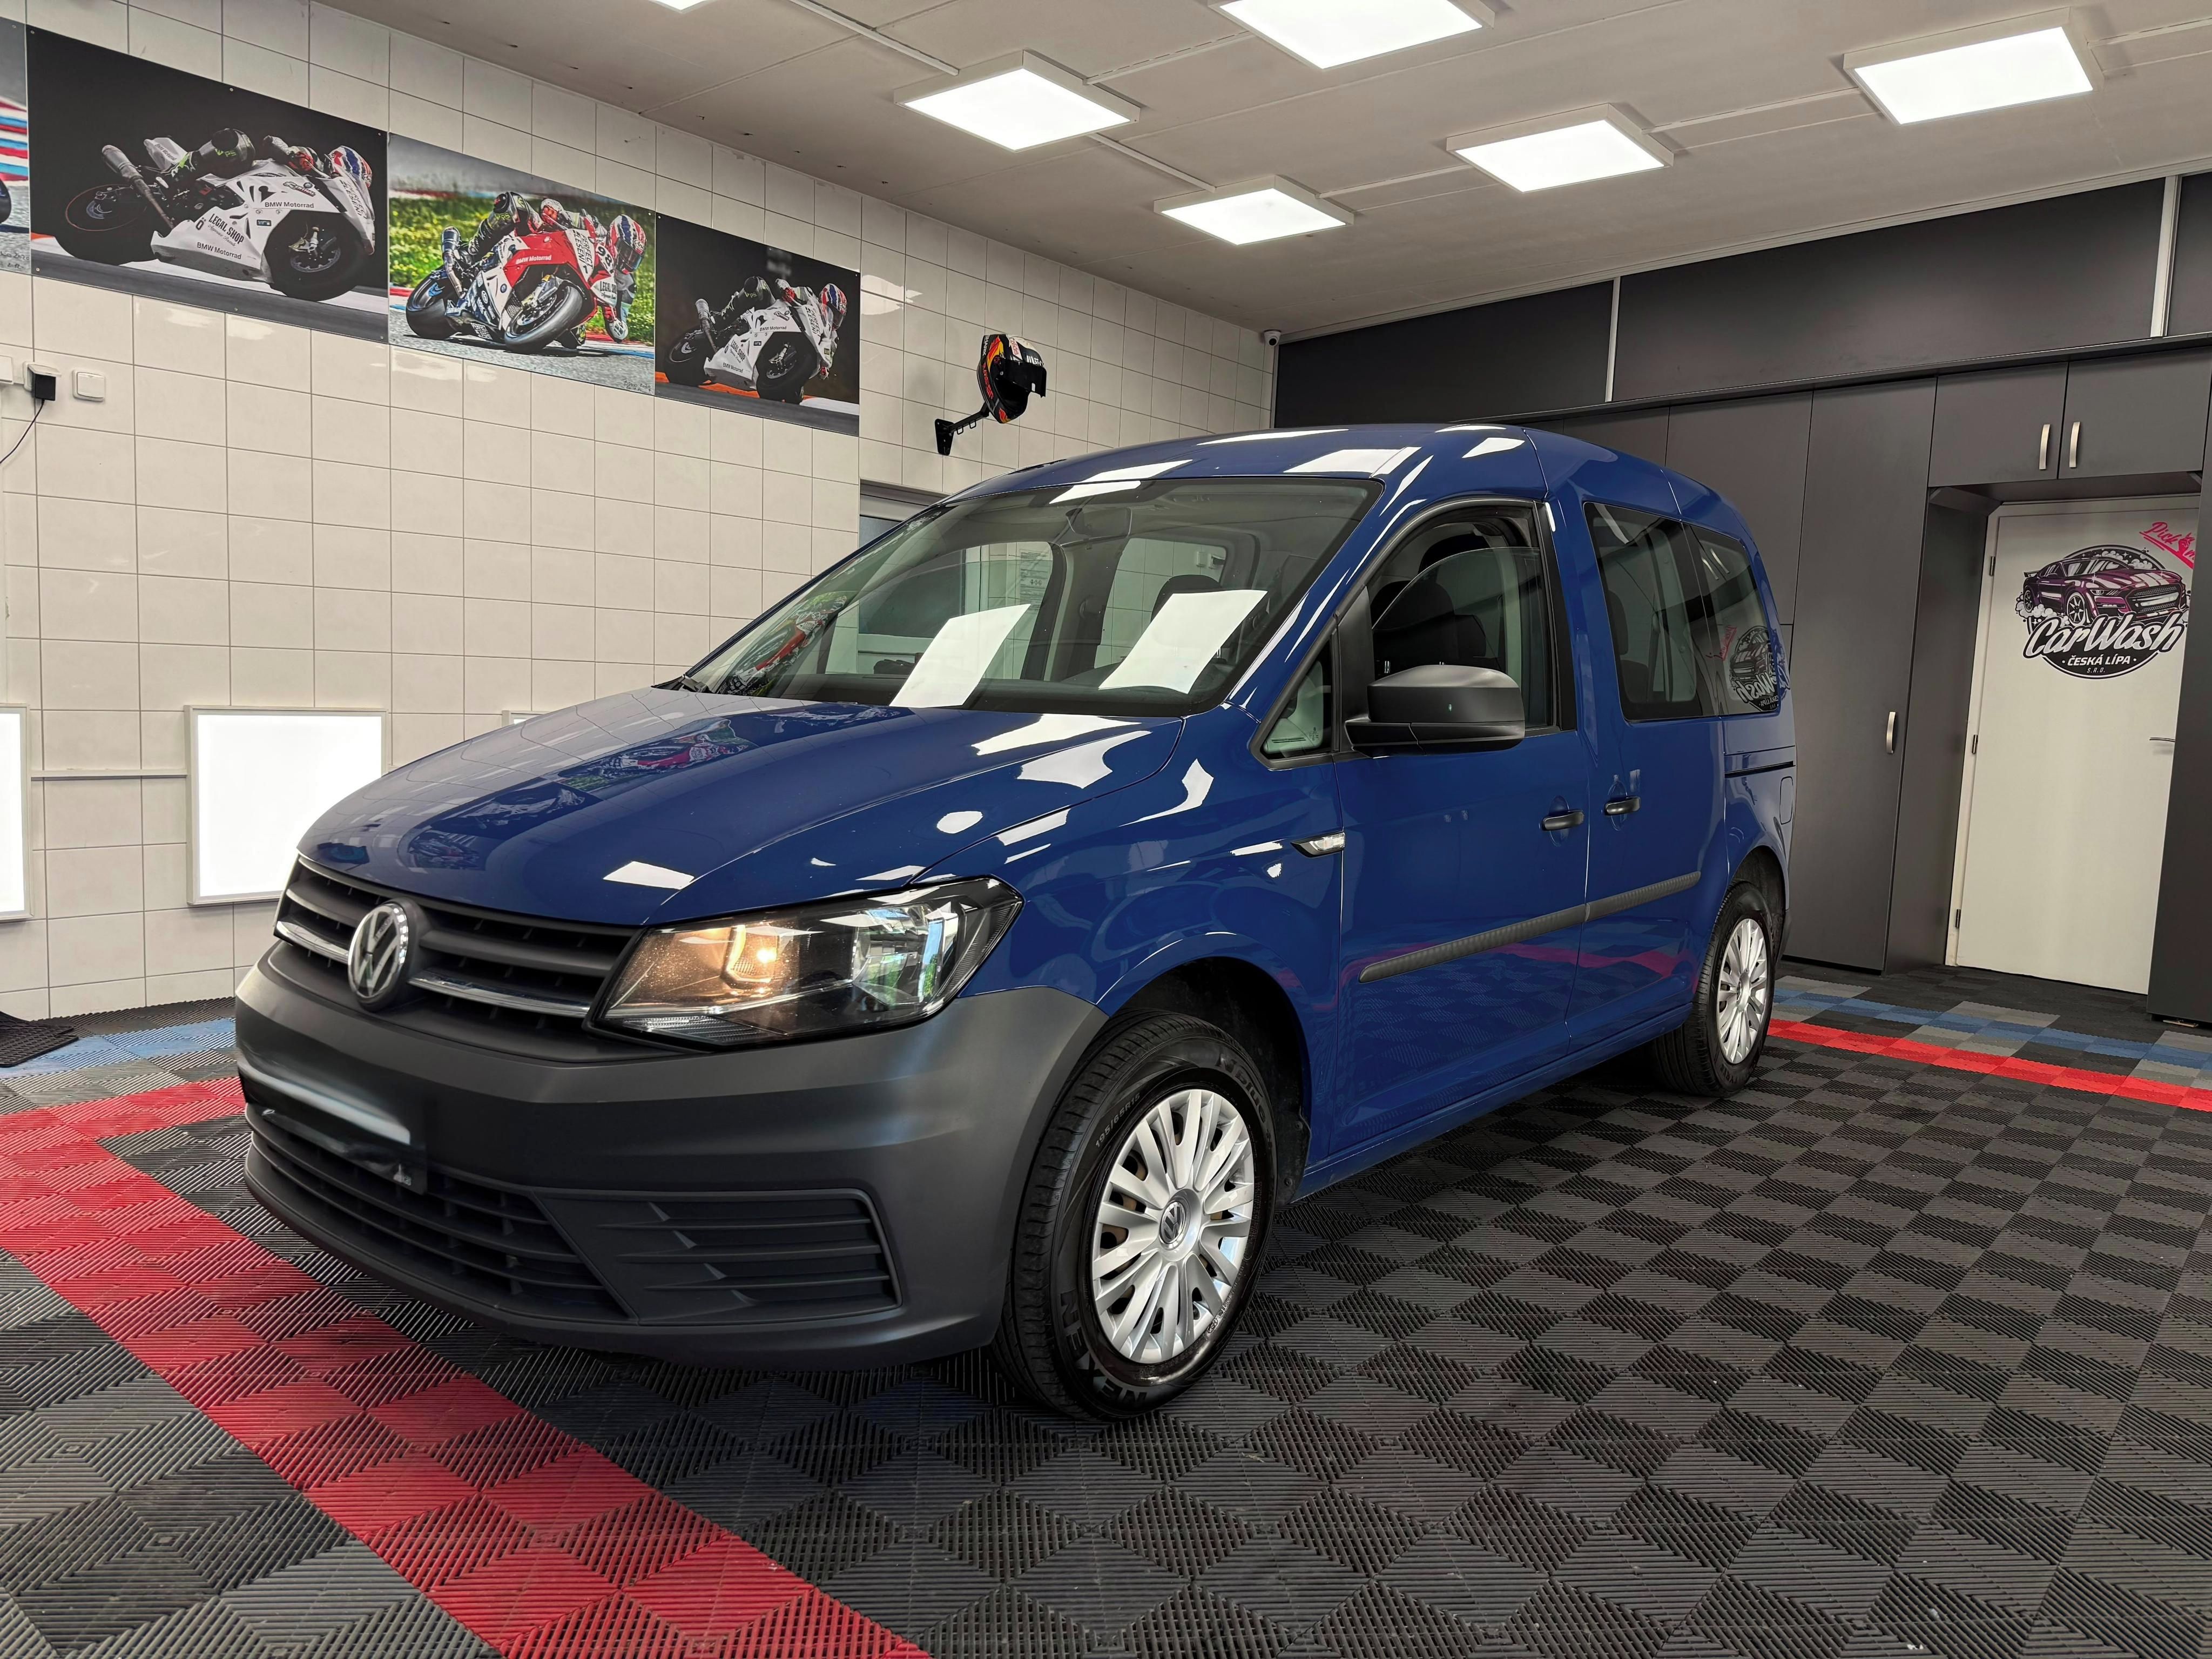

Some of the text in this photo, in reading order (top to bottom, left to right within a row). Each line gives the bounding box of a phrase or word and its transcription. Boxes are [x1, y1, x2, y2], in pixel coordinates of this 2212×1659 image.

[209, 213, 227, 232] LEGAL
[226, 227, 244, 244] SHOP
[197, 242, 242, 259] BMW Motorrad
[581, 234, 593, 269] PERFECT
[596, 246, 612, 266] 98
[2024, 612, 2183, 657] CarWash
[2067, 653, 2130, 666] ČESKÁ LÍPA
[1096, 1092, 1140, 1148] 195/65R15
